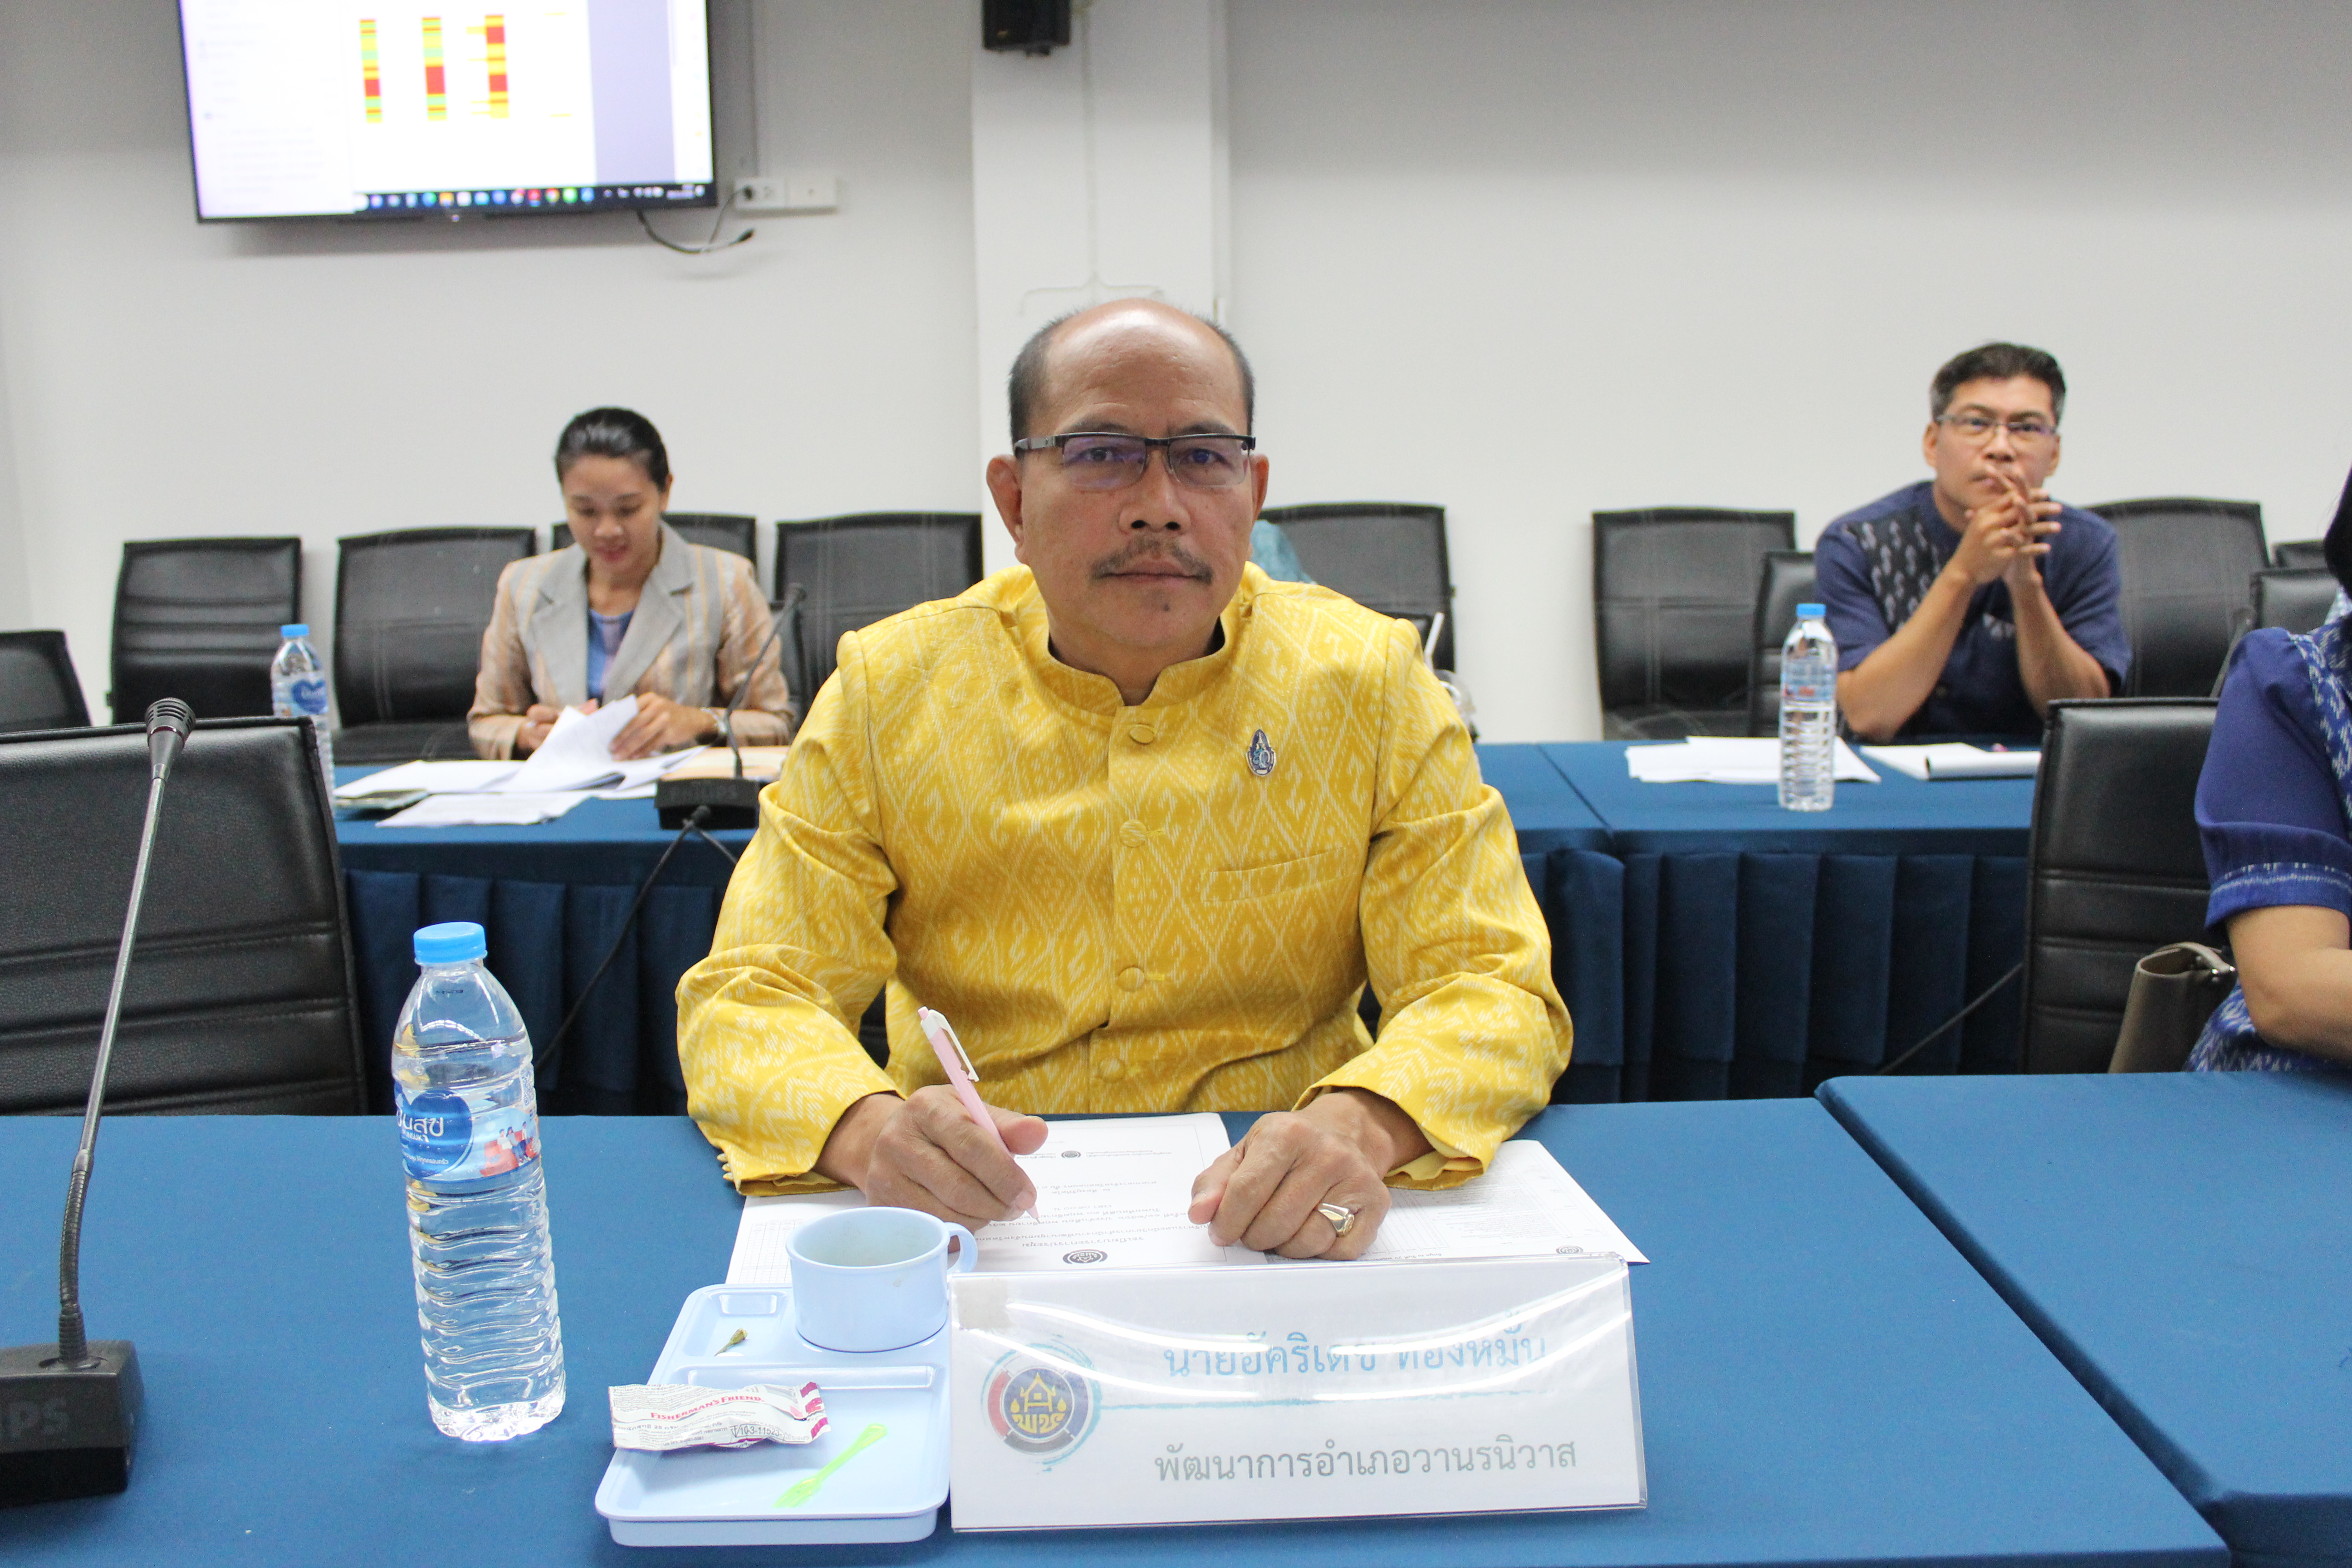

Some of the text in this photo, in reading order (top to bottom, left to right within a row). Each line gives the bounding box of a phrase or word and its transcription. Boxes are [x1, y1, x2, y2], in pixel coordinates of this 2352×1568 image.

[1021, 1236, 1144, 1248] ระเบียบวาระการประชุม
[650, 1399, 720, 1420] FISHERMAN'S
[1155, 1435, 1577, 1482] พัฒนาการอำเภอวานรนิวาส
